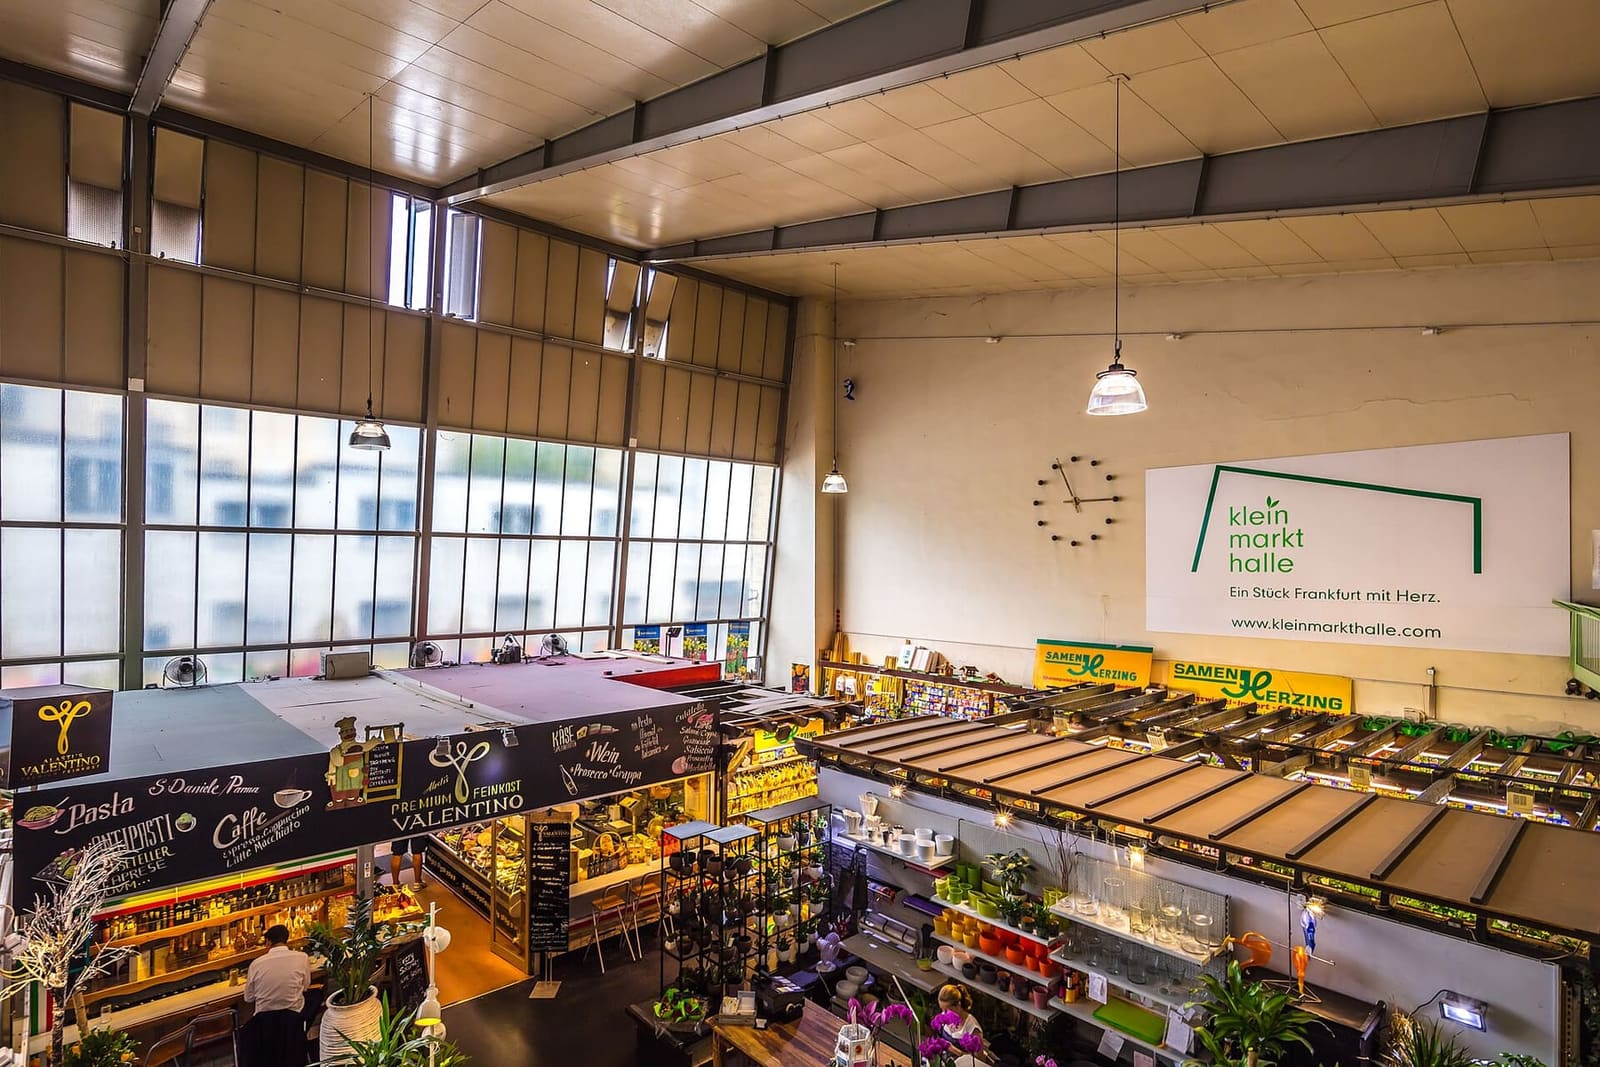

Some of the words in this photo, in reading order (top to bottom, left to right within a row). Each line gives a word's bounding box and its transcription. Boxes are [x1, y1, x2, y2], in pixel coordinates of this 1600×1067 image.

[1229, 504, 1289, 526] klein
[1229, 527, 1305, 549] markt
[1229, 552, 1295, 574] halle
[1229, 586, 1250, 599] Ein
[1252, 586, 1290, 600] Stück
[1294, 587, 1362, 602] Frankfurt
[1366, 589, 1392, 602] mit
[1396, 589, 1442, 604] Herz.
[1231, 618, 1442, 639] www.kleinmarkthalle.com
[1045, 651, 1084, 663] SAMEN
[1067, 654, 1137, 681] HERZING
[1173, 663, 1239, 681] SAMEN
[1221, 670, 1344, 711] HERZING
[551, 724, 575, 748] KÄSE
[589, 741, 620, 764] Wein
[21, 755, 101, 776] VALENTINO
[573, 763, 609, 780] Prosecco
[611, 764, 642, 785] Grappa
[148, 778, 168, 796] S
[473, 780, 522, 800] FEINKOST
[54, 791, 136, 834] Pasta
[391, 793, 452, 816] PREMIUM
[392, 794, 524, 832] VALENTINO
[226, 848, 252, 869] Latte
[254, 821, 301, 854] Macchiato
